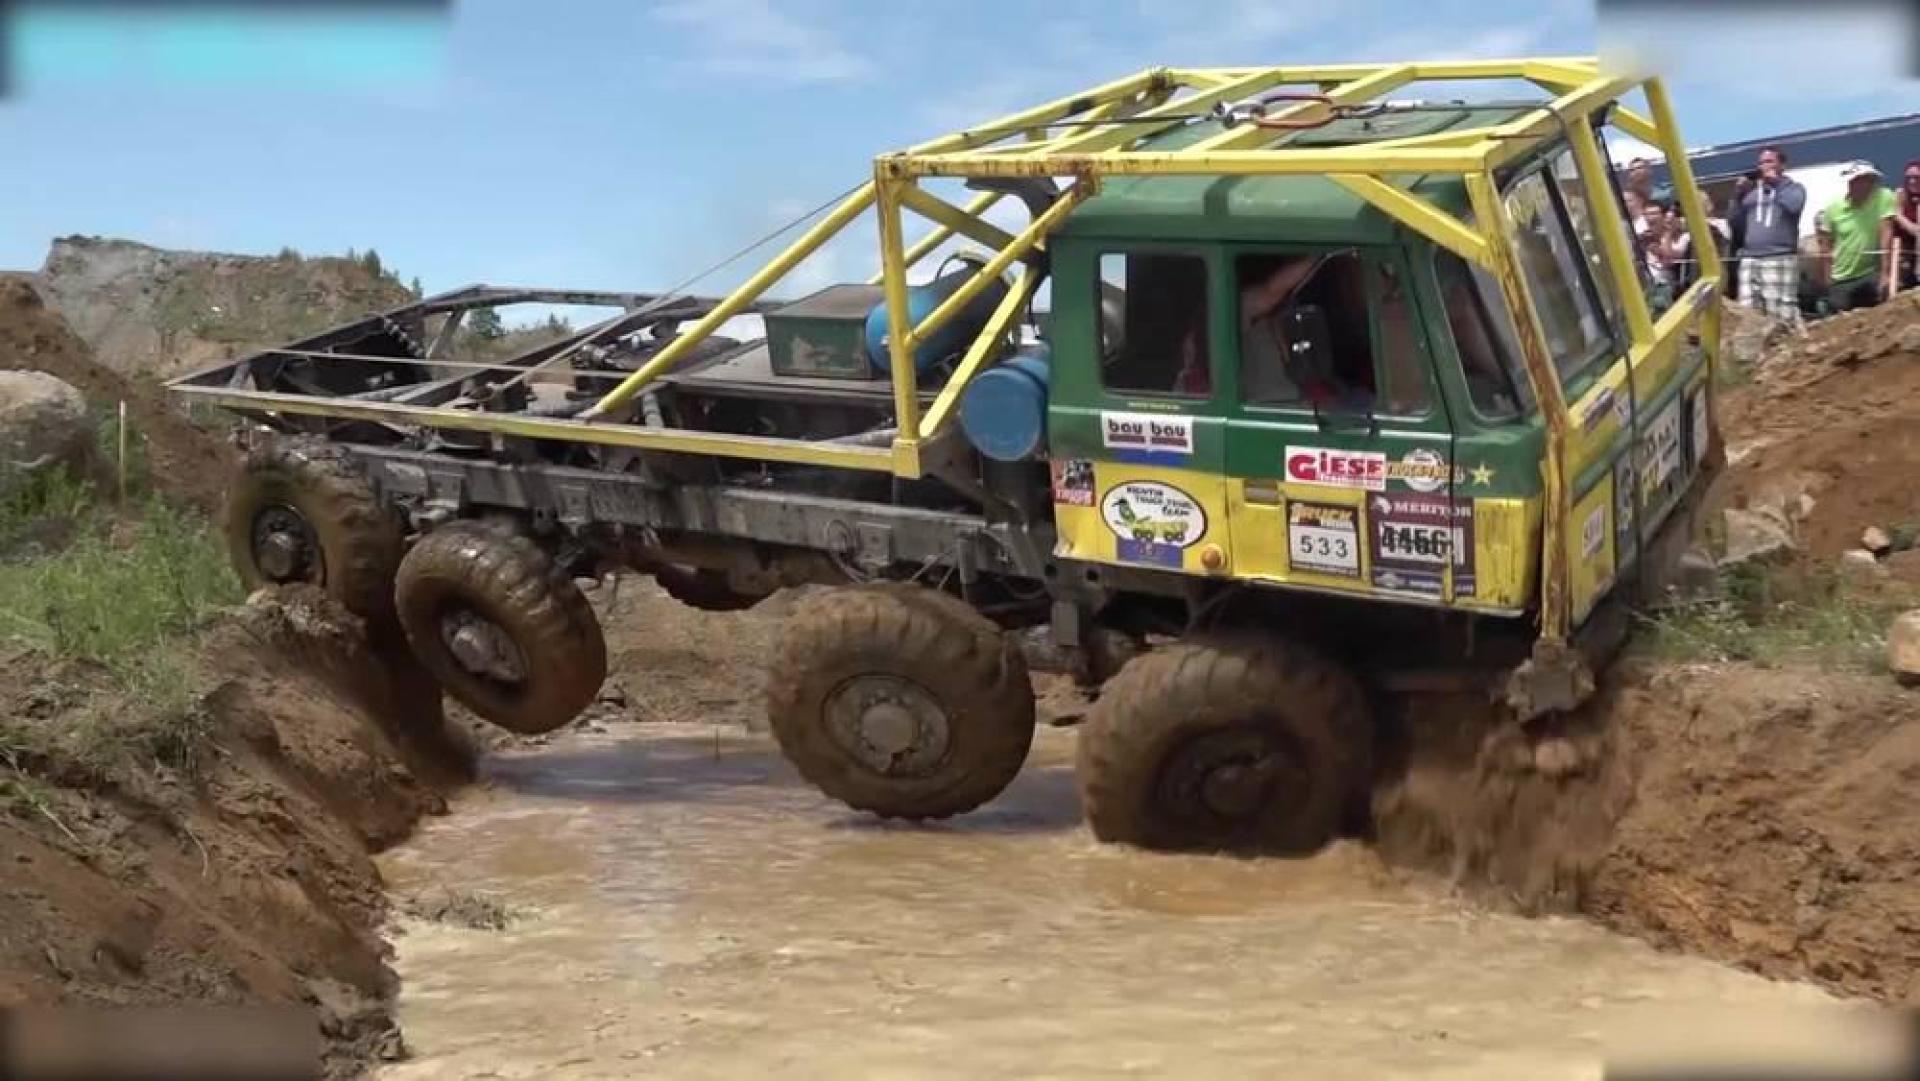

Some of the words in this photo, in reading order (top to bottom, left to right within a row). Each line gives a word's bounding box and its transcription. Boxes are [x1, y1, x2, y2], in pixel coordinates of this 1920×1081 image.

[1108, 418, 1143, 433] bau
[1150, 420, 1186, 436] bau
[1300, 535, 1348, 558] 533
